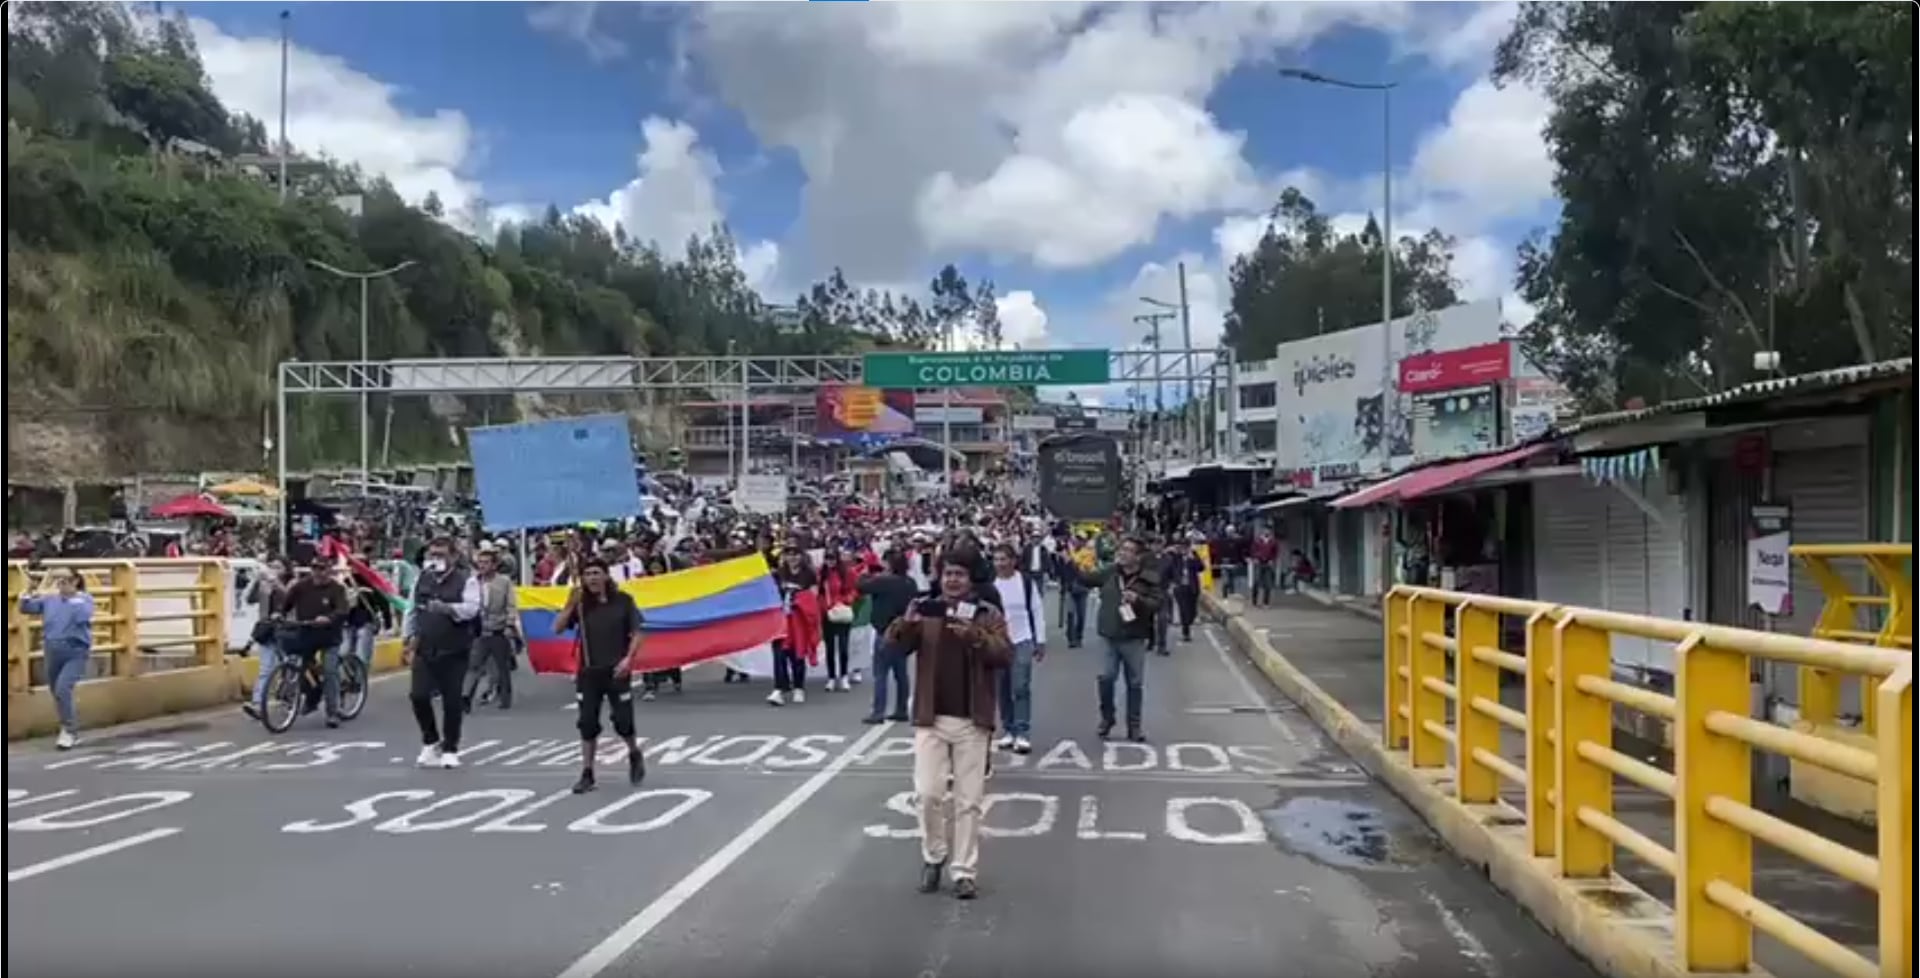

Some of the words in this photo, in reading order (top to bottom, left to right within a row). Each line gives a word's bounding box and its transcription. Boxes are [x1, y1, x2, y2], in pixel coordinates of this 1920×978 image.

[918, 364, 1052, 382] COLOMBIA
[1405, 367, 1440, 384] Claro
[281, 788, 714, 833] SOLO
